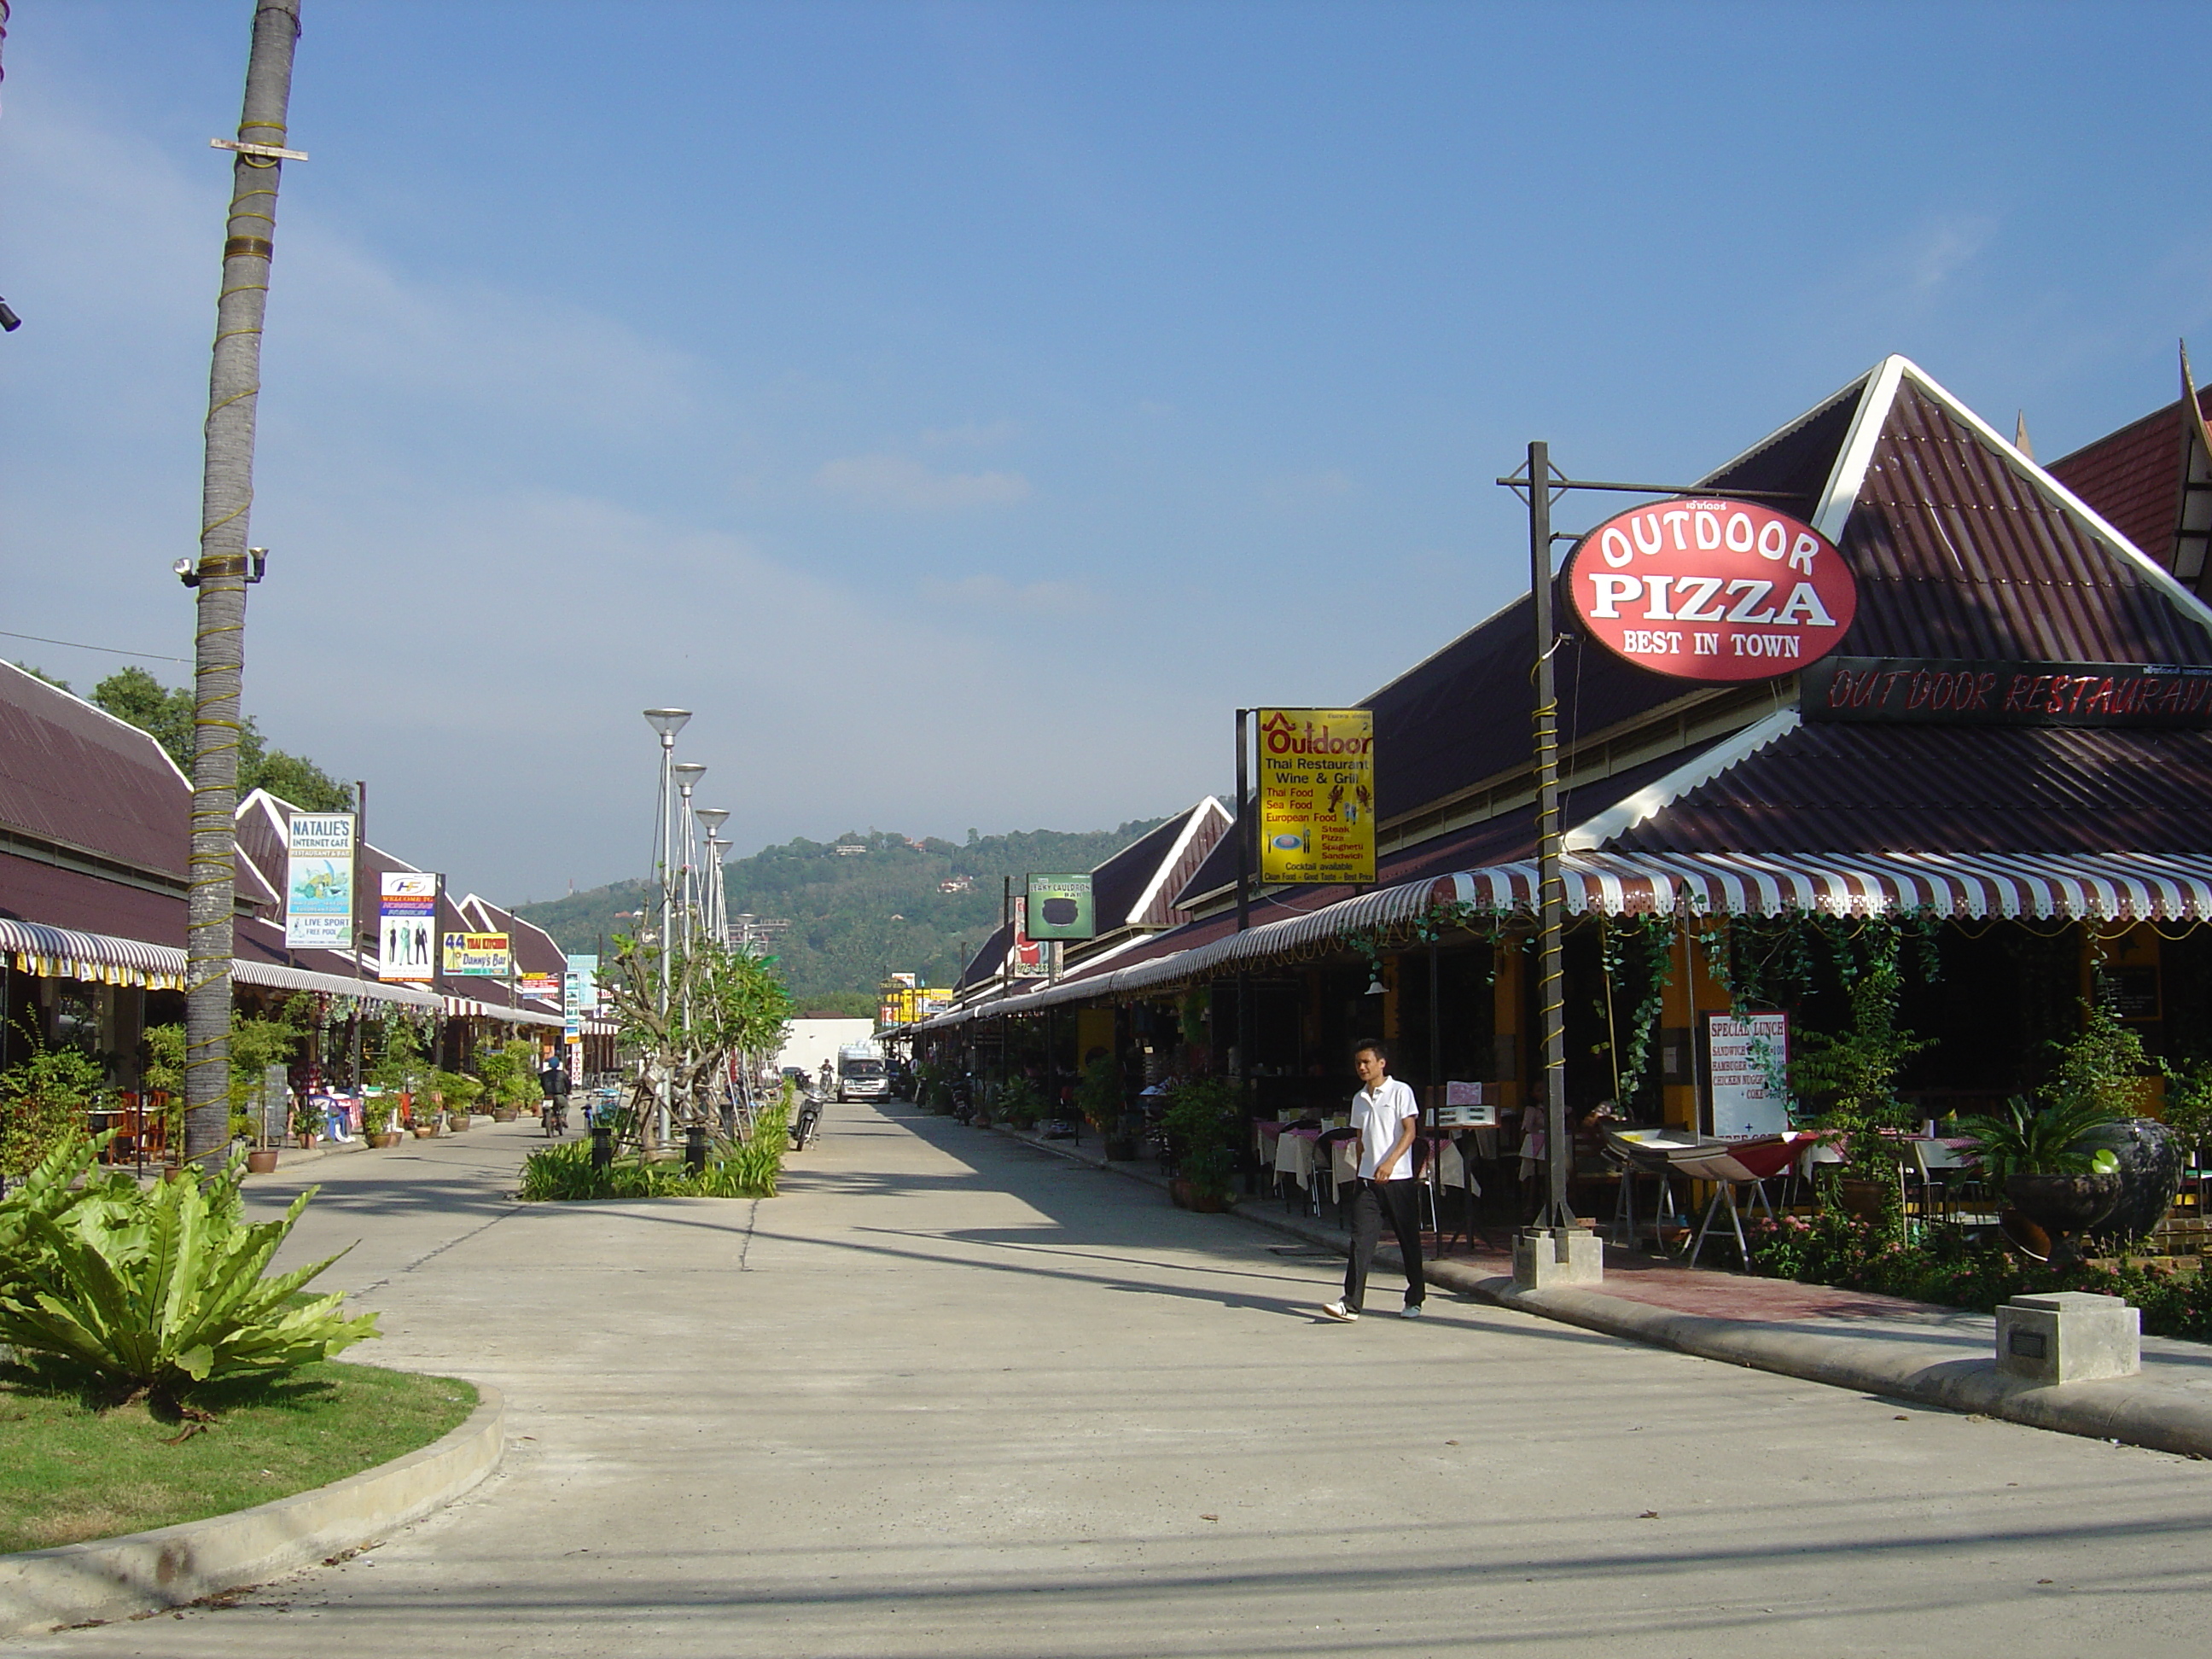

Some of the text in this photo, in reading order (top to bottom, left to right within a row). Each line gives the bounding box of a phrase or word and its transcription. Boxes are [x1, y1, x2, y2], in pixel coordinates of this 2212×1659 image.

[1601, 510, 1819, 576] OUTDOOR
[1589, 573, 1836, 626] PIZZA
[1624, 630, 1800, 657] BEST IN TOWN
[1267, 721, 1373, 754] Outdoor
[1266, 758, 1369, 770] Thai Restaurant
[1276, 772, 1359, 784] Wine & Grill
[1266, 788, 1313, 797] Thai Food
[1266, 800, 1313, 809] Sea Food
[1266, 812, 1336, 824] European Food
[293, 820, 349, 835] NATALIE'S
[293, 836, 348, 847] INTERNET CAFÉ
[1322, 843, 1364, 852] Spaghetti
[1285, 862, 1353, 870] Cocktail available
[1030, 883, 1090, 892] LEAKY CAULDRON
[445, 934, 465, 949] 44
[492, 953, 506, 966] Bar
[1711, 1022, 1784, 1037] SPECIAL LUNCH
[1712, 1046, 1745, 1056] SANDWICH
[1714, 1075, 1741, 1086] CHICKEN
[1747, 1089, 1764, 1099] COKE
